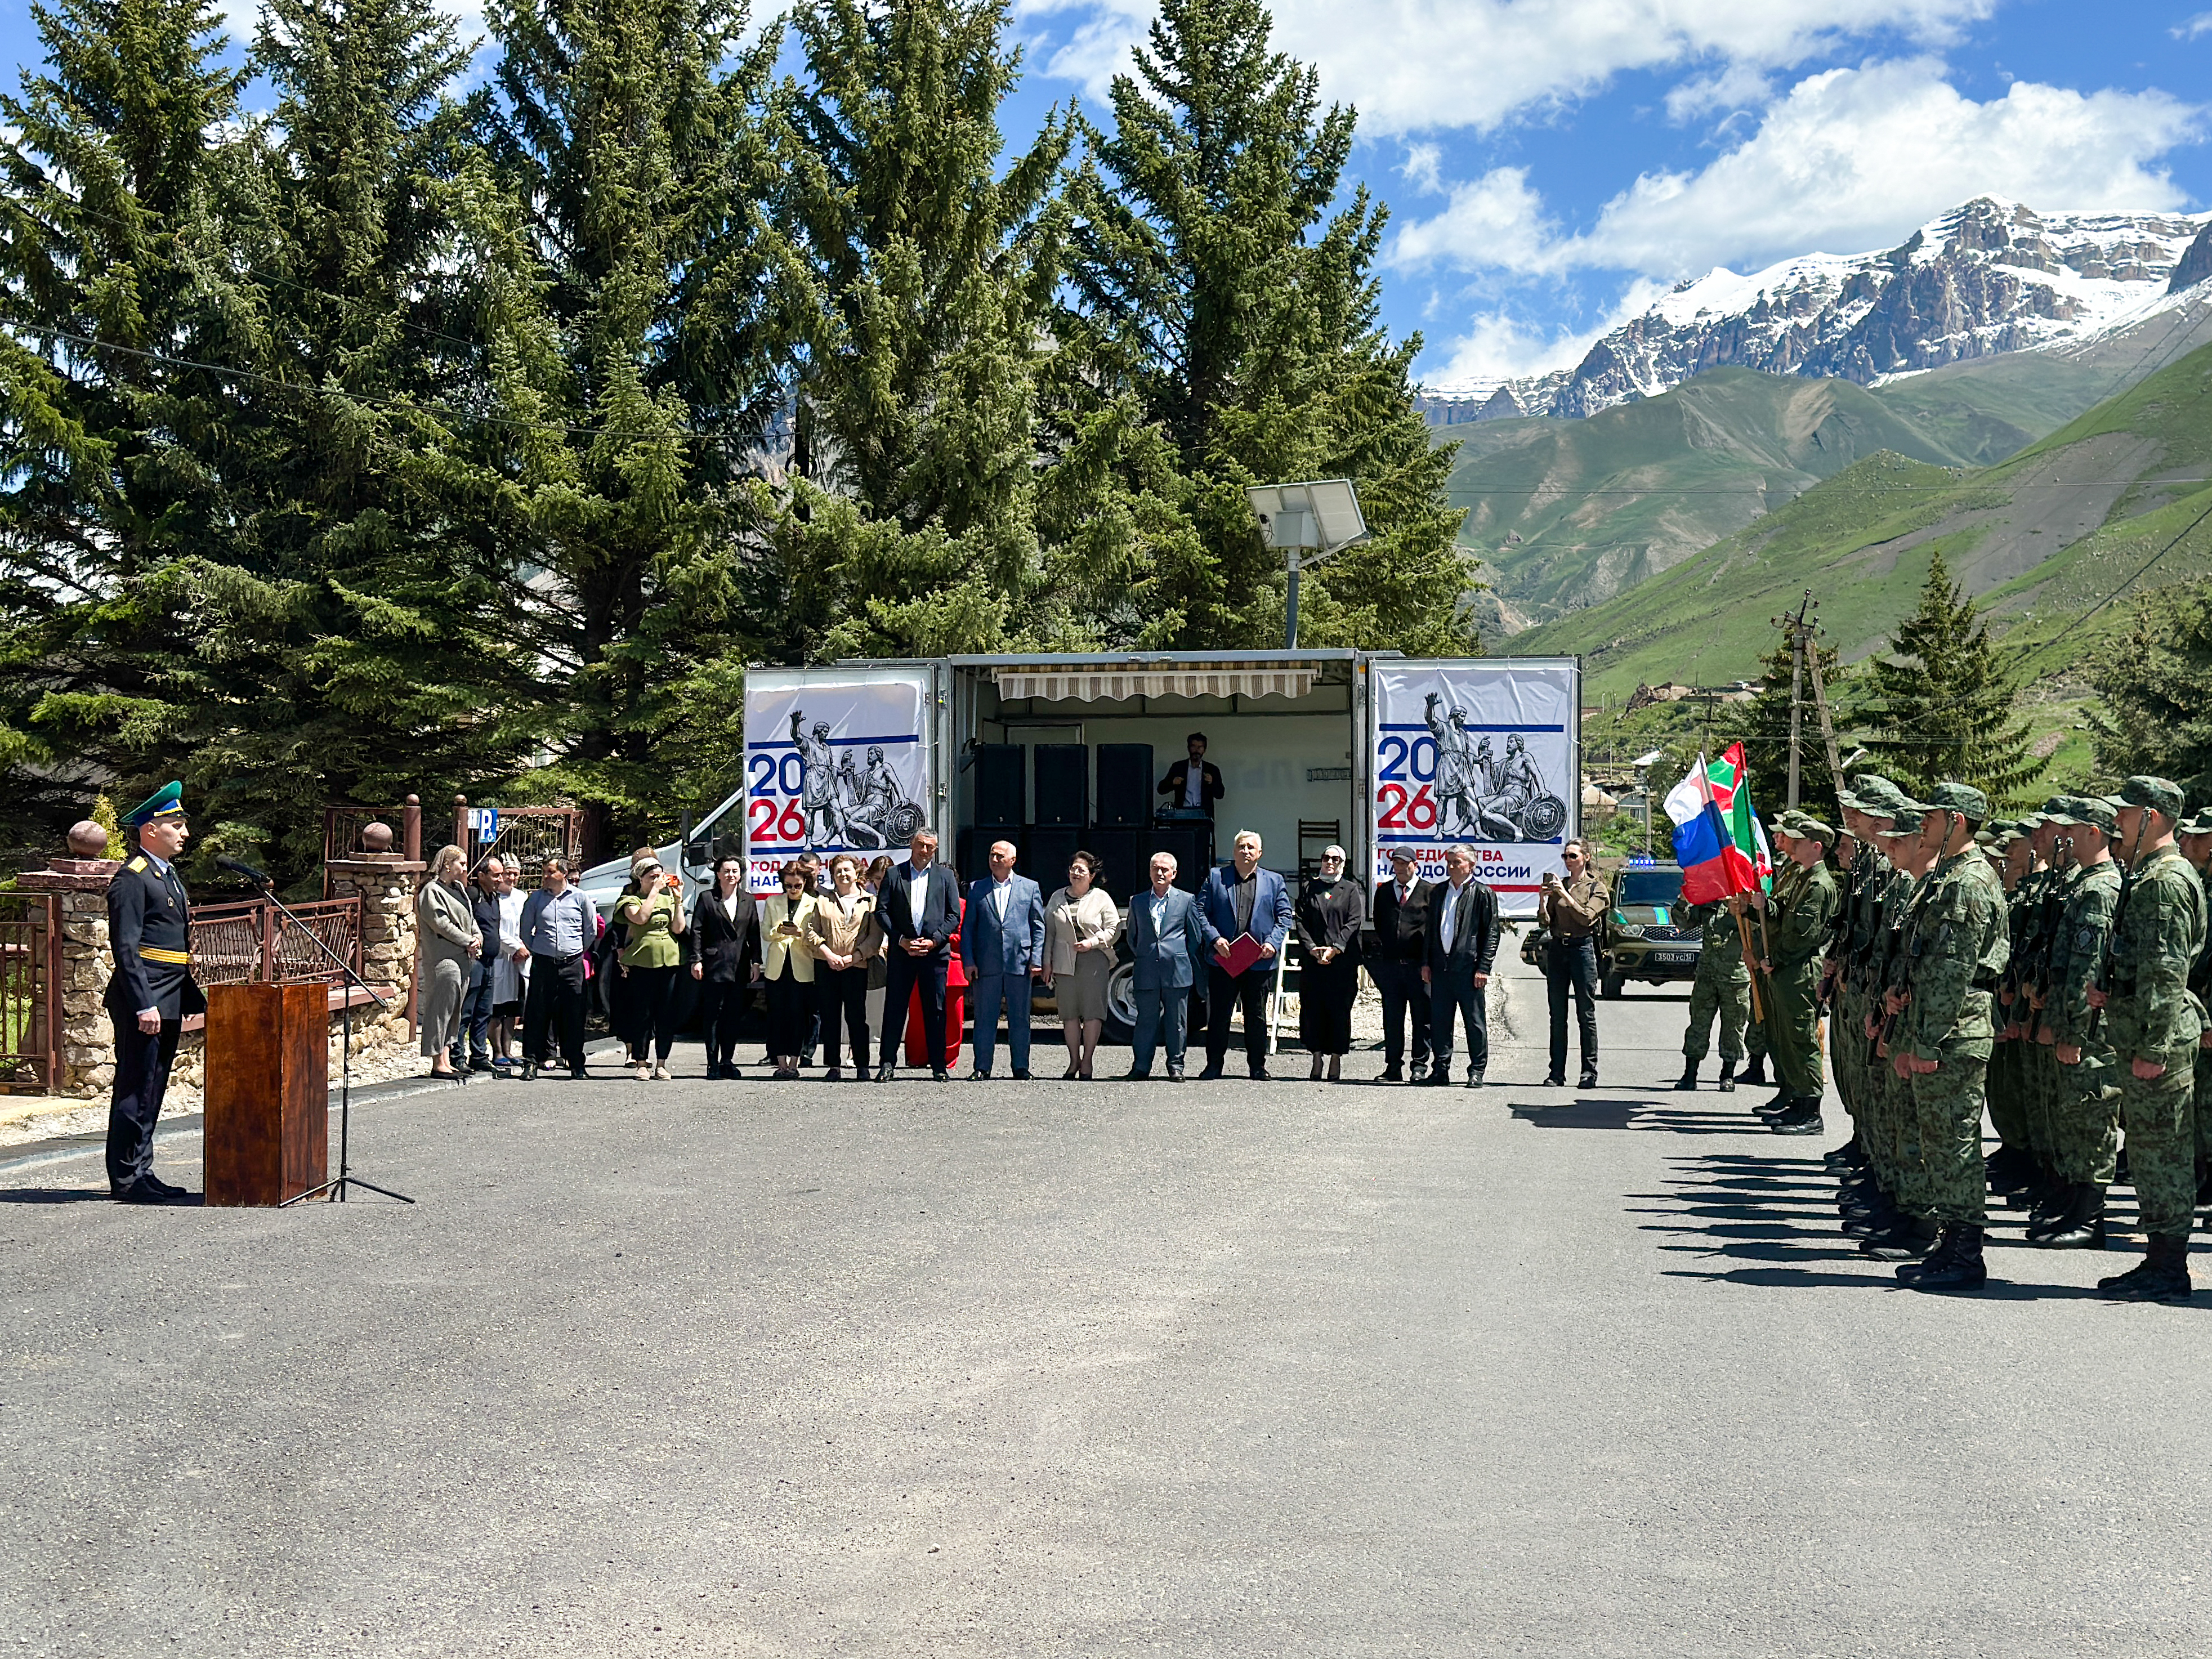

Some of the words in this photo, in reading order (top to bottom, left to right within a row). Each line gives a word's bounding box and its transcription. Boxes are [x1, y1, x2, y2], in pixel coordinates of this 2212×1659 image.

[1378, 736, 1441, 782] 20
[748, 753, 806, 797] 20
[749, 798, 805, 841] 26
[1377, 784, 1437, 829] 26
[481, 810, 493, 839] P
[751, 861, 780, 873] ГОД
[1416, 849, 1504, 862] ЕДИТВА
[751, 875, 825, 887] НАРВ
[1471, 866, 1531, 878] ОССИИ
